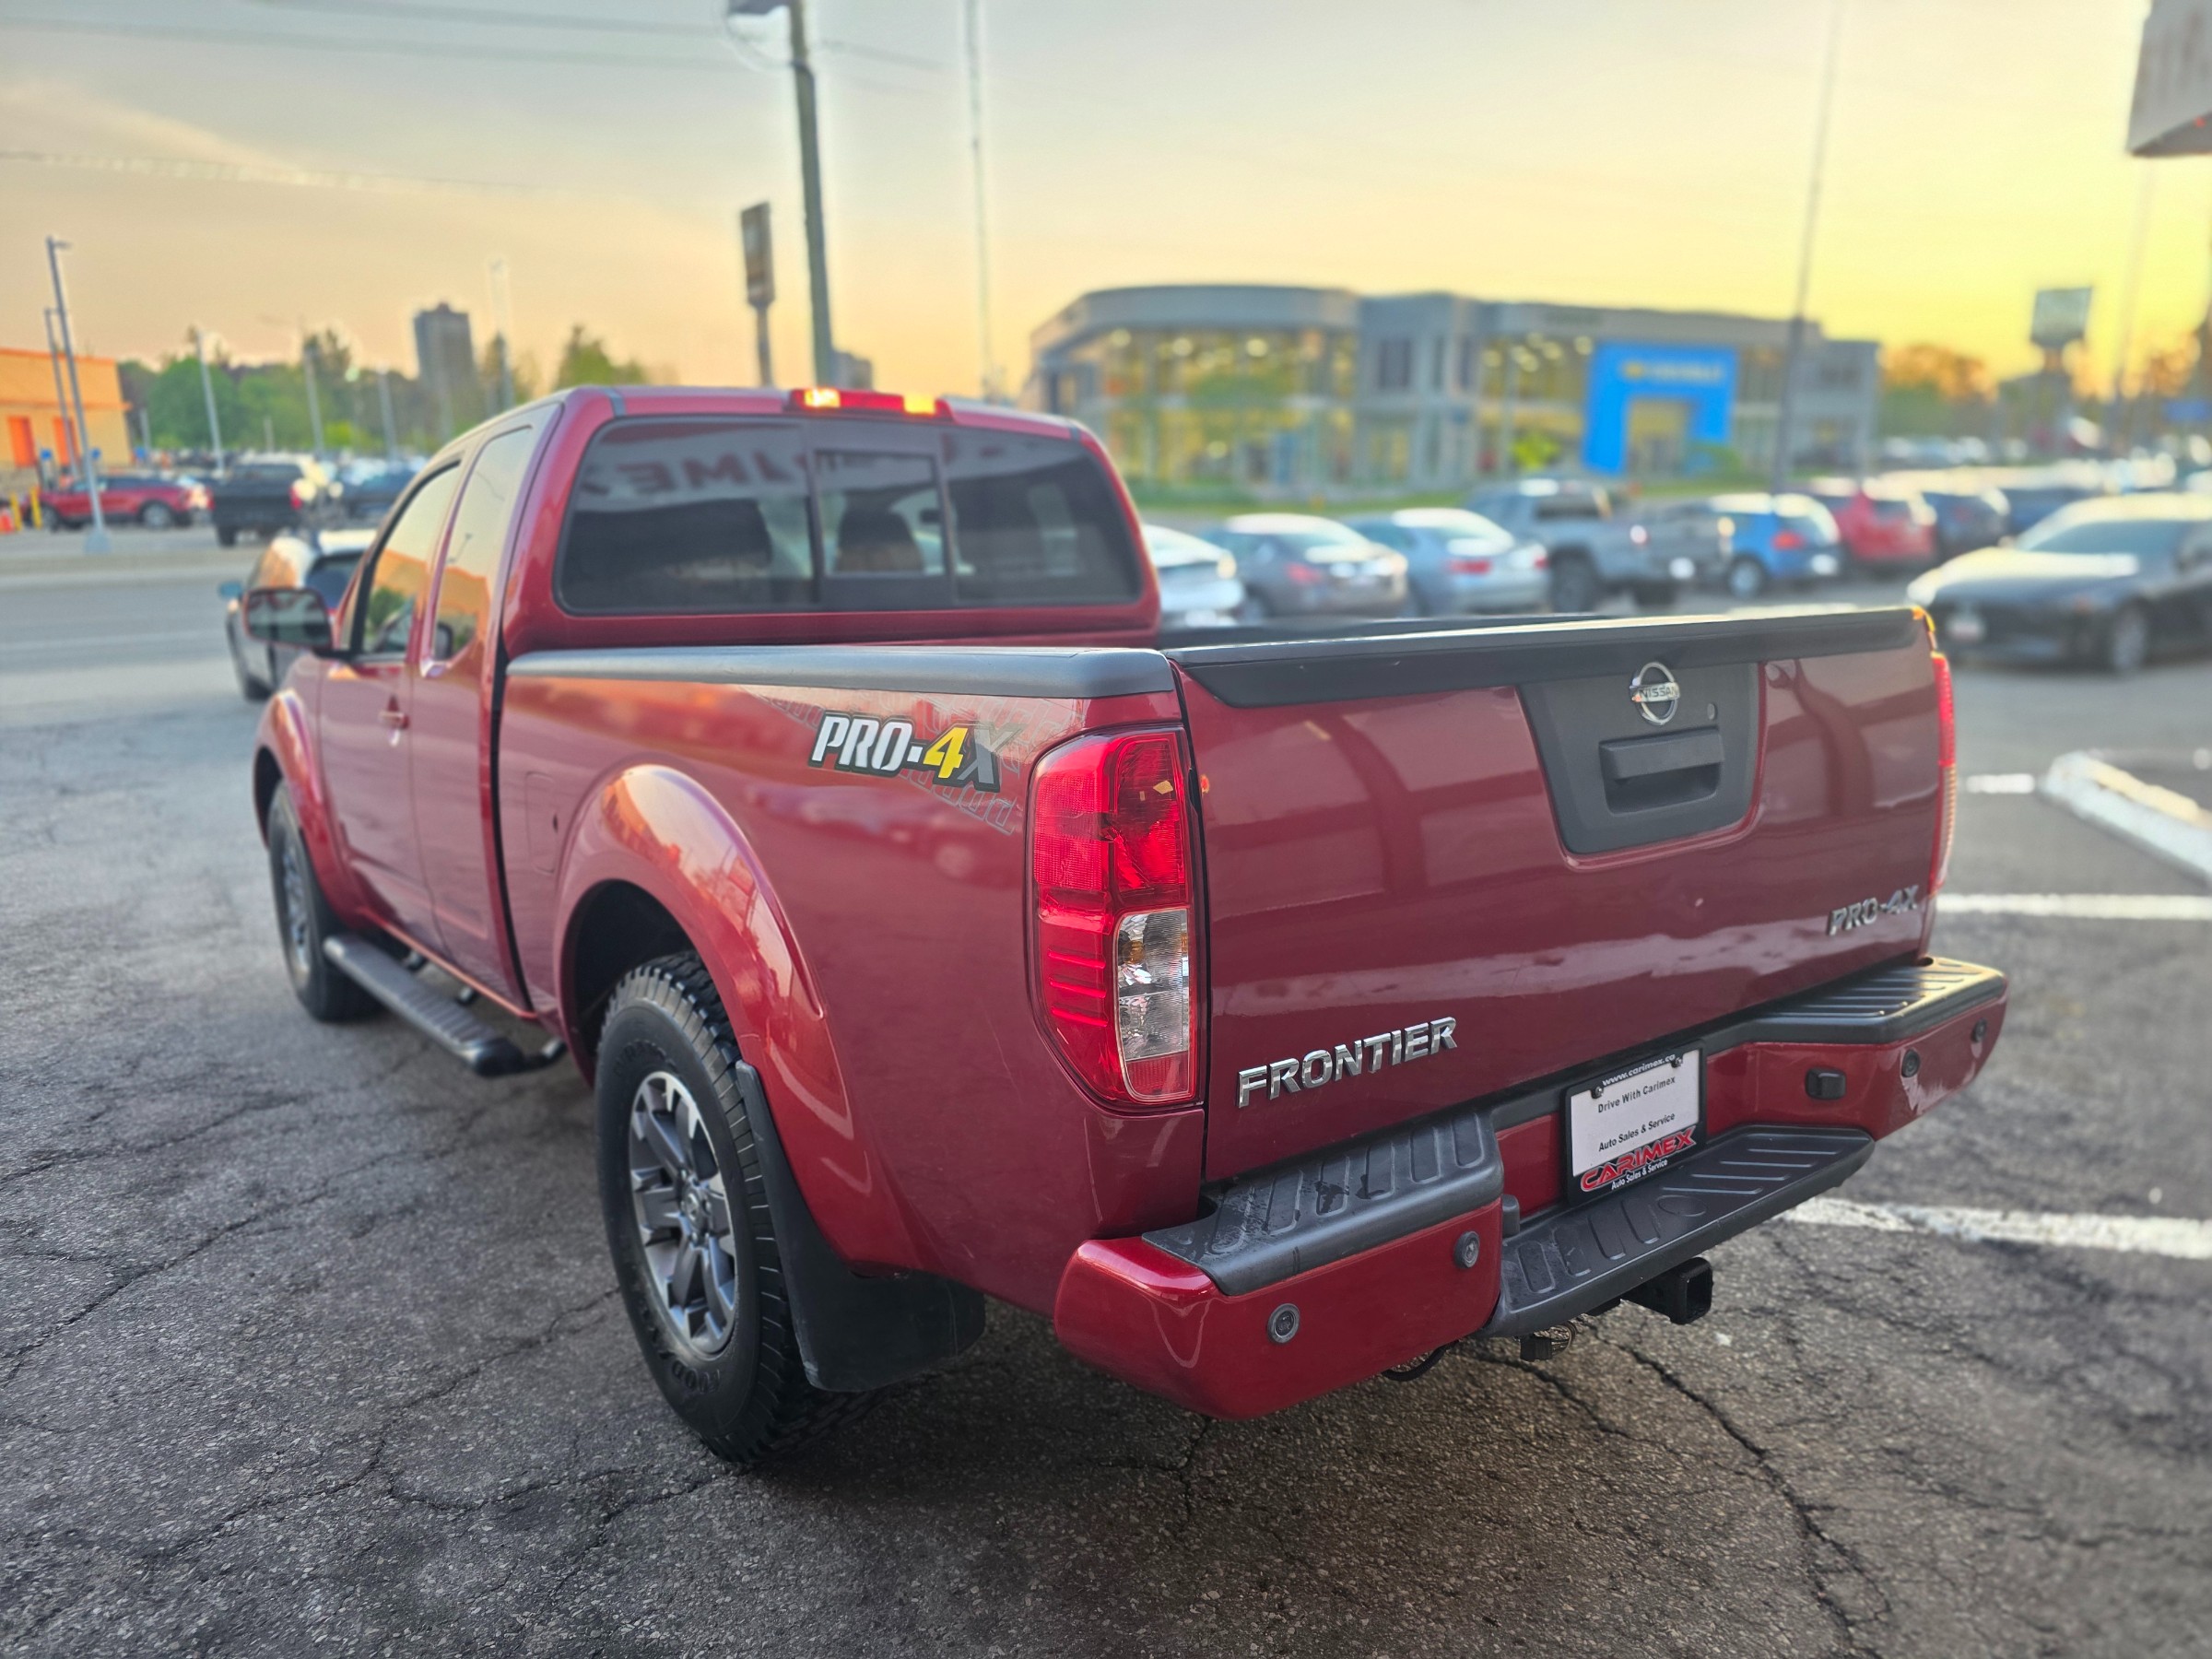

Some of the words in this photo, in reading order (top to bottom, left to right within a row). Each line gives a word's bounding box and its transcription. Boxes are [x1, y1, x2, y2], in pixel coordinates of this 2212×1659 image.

[1640, 685, 1677, 699] NISSAN
[809, 713, 1023, 789] PRO-4X
[1828, 885, 1919, 936] PRO-4X
[1239, 1017, 1458, 1109] FRONTIER
[1597, 1099, 1620, 1113] Drive
[1622, 1088, 1641, 1104] With
[1642, 1077, 1676, 1095] Carimex
[1598, 1139, 1617, 1152] Auto
[1618, 1128, 1639, 1144] Sales
[1641, 1124, 1647, 1134] &
[1648, 1112, 1676, 1130] Service
[1581, 1125, 1697, 1192] CARIMEX
[1611, 1179, 1625, 1191] Auto
[1626, 1170, 1641, 1182] Sales
[1647, 1159, 1668, 1173] Service
